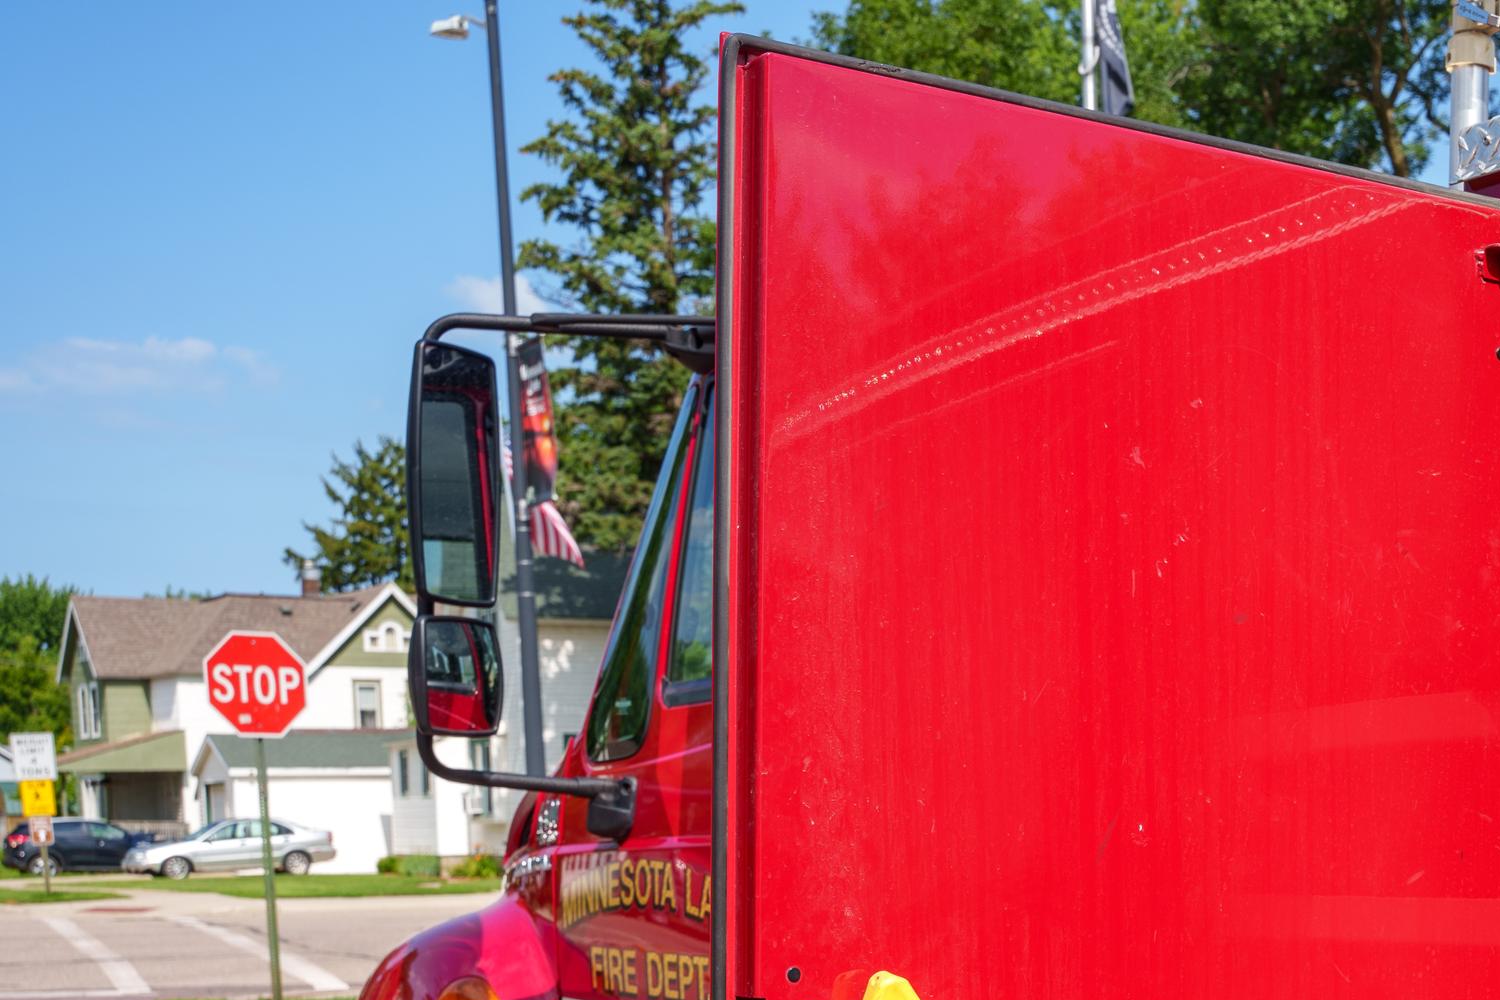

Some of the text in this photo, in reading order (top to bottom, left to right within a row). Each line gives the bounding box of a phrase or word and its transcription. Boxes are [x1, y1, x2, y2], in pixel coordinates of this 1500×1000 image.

[212, 662, 301, 705] STOP
[561, 859, 676, 930] MINNESOTA
[590, 945, 638, 996] FIRE
